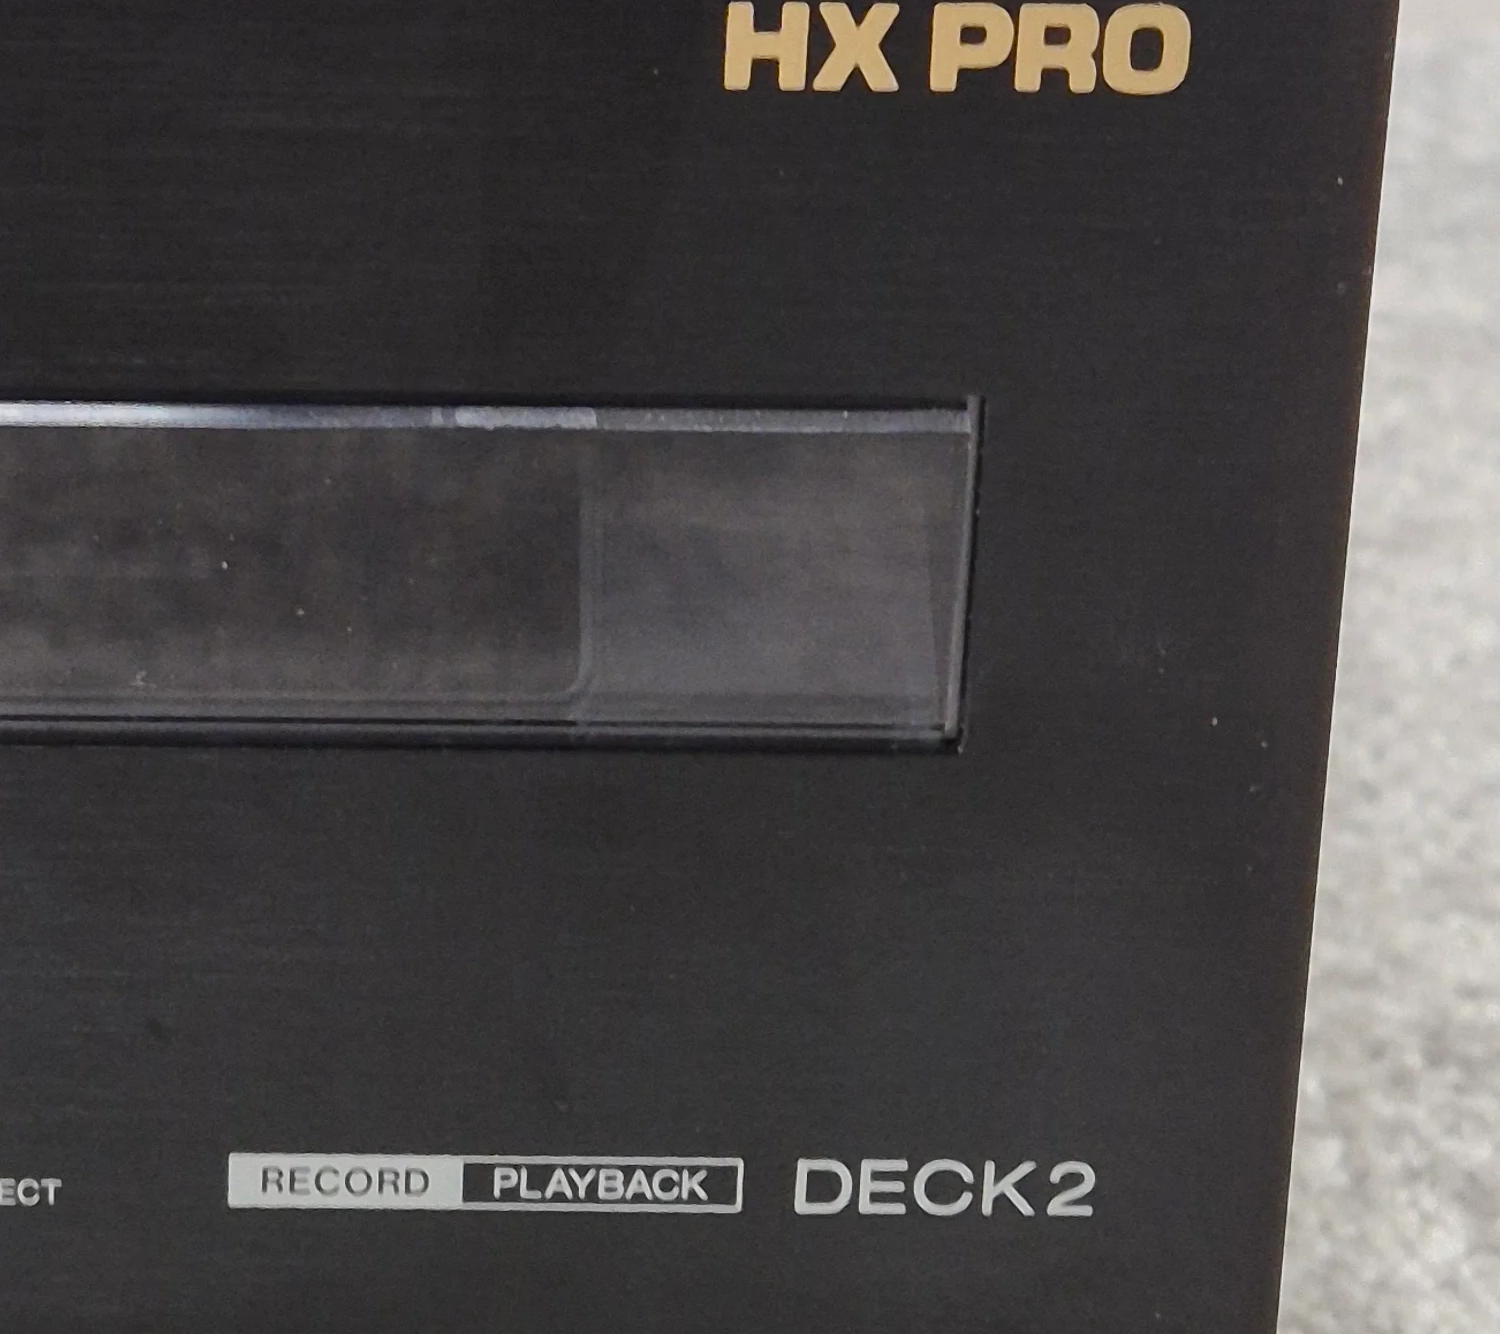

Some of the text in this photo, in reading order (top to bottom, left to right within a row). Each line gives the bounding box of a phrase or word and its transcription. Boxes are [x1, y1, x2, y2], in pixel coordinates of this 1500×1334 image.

[723, 1, 1192, 95] HX PRO
[261, 1166, 710, 1202] RECORD PLAYBACK
